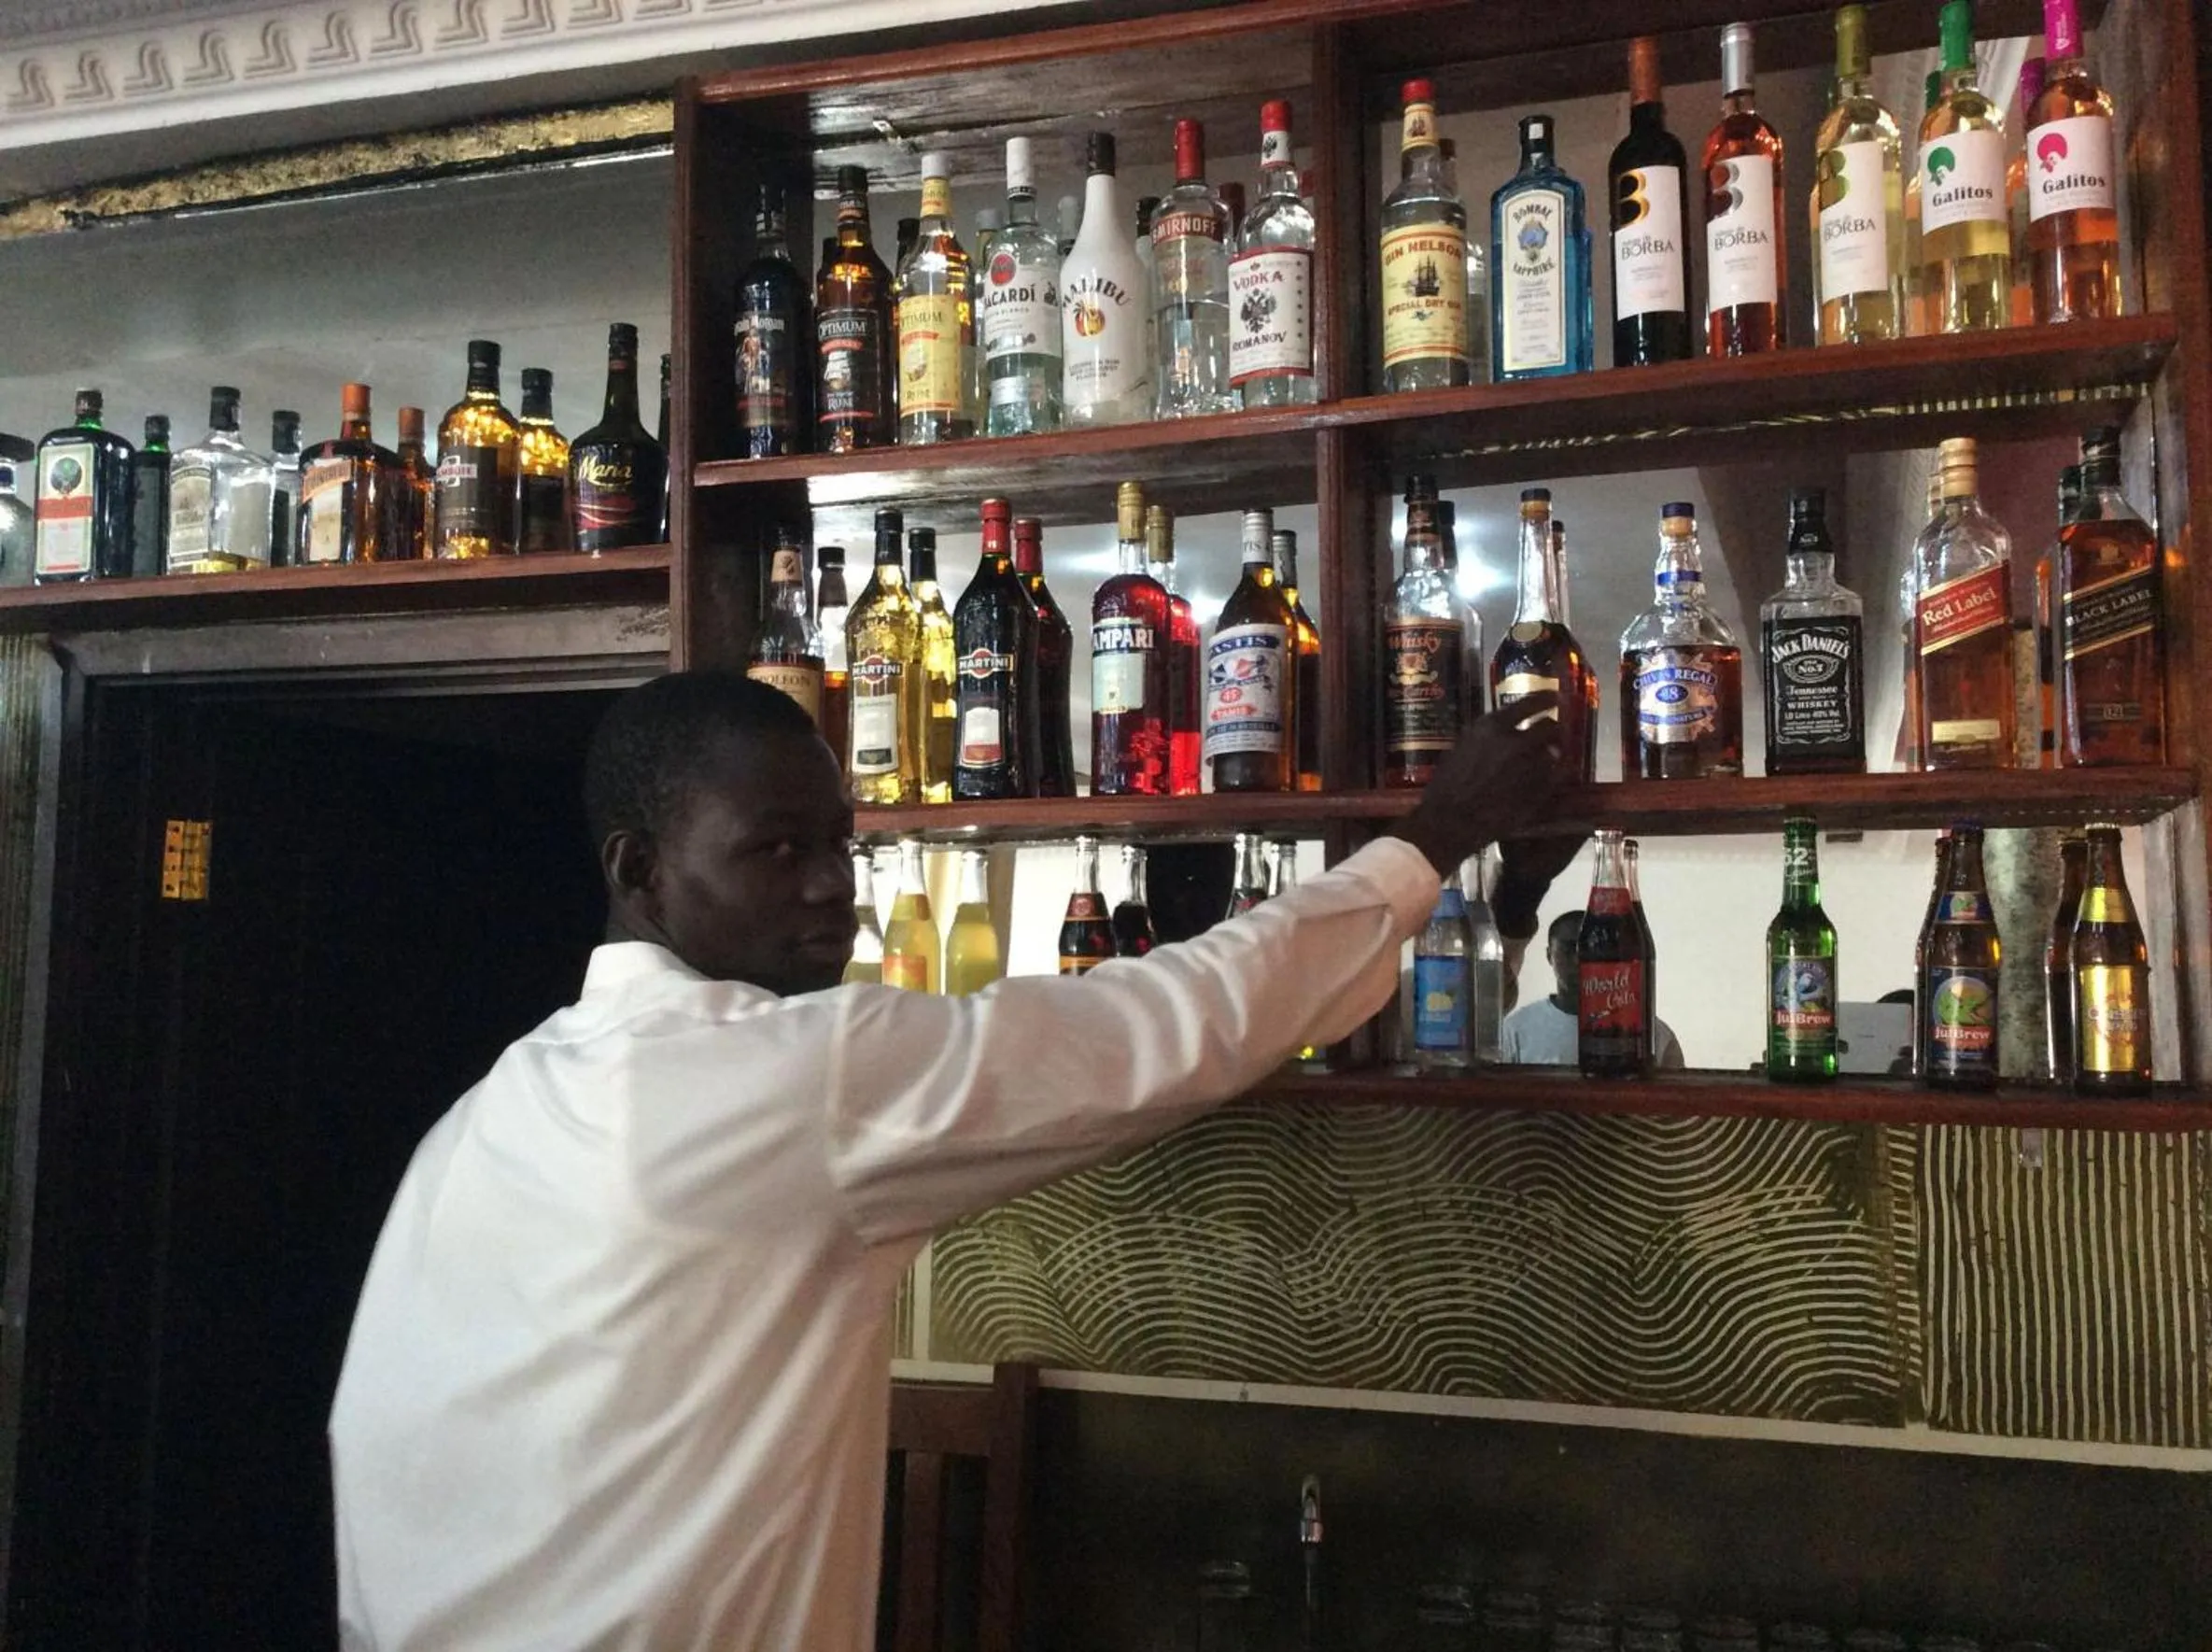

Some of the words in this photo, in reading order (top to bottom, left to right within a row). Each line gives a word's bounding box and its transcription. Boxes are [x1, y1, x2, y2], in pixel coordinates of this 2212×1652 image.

[2043, 173, 2106, 195] Galitos
[1932, 186, 1994, 207] Galitos
[1621, 238, 1675, 261] BORBA
[1714, 230, 1769, 251] BORBA
[1233, 270, 1284, 292] VODKA
[900, 311, 943, 329] TIMUM
[1232, 331, 1288, 352] ROMANOV
[1922, 602, 1954, 627] Red
[1954, 586, 1997, 614] Label
[1092, 627, 1154, 650] AMPARI
[1211, 636, 1268, 656] ASTIS
[1770, 639, 1802, 664] JACK
[852, 664, 901, 676] MARTINI
[959, 657, 1008, 670] MARTINI
[1674, 668, 1713, 685] REGAL
[1786, 699, 1839, 710] WHISKEY
